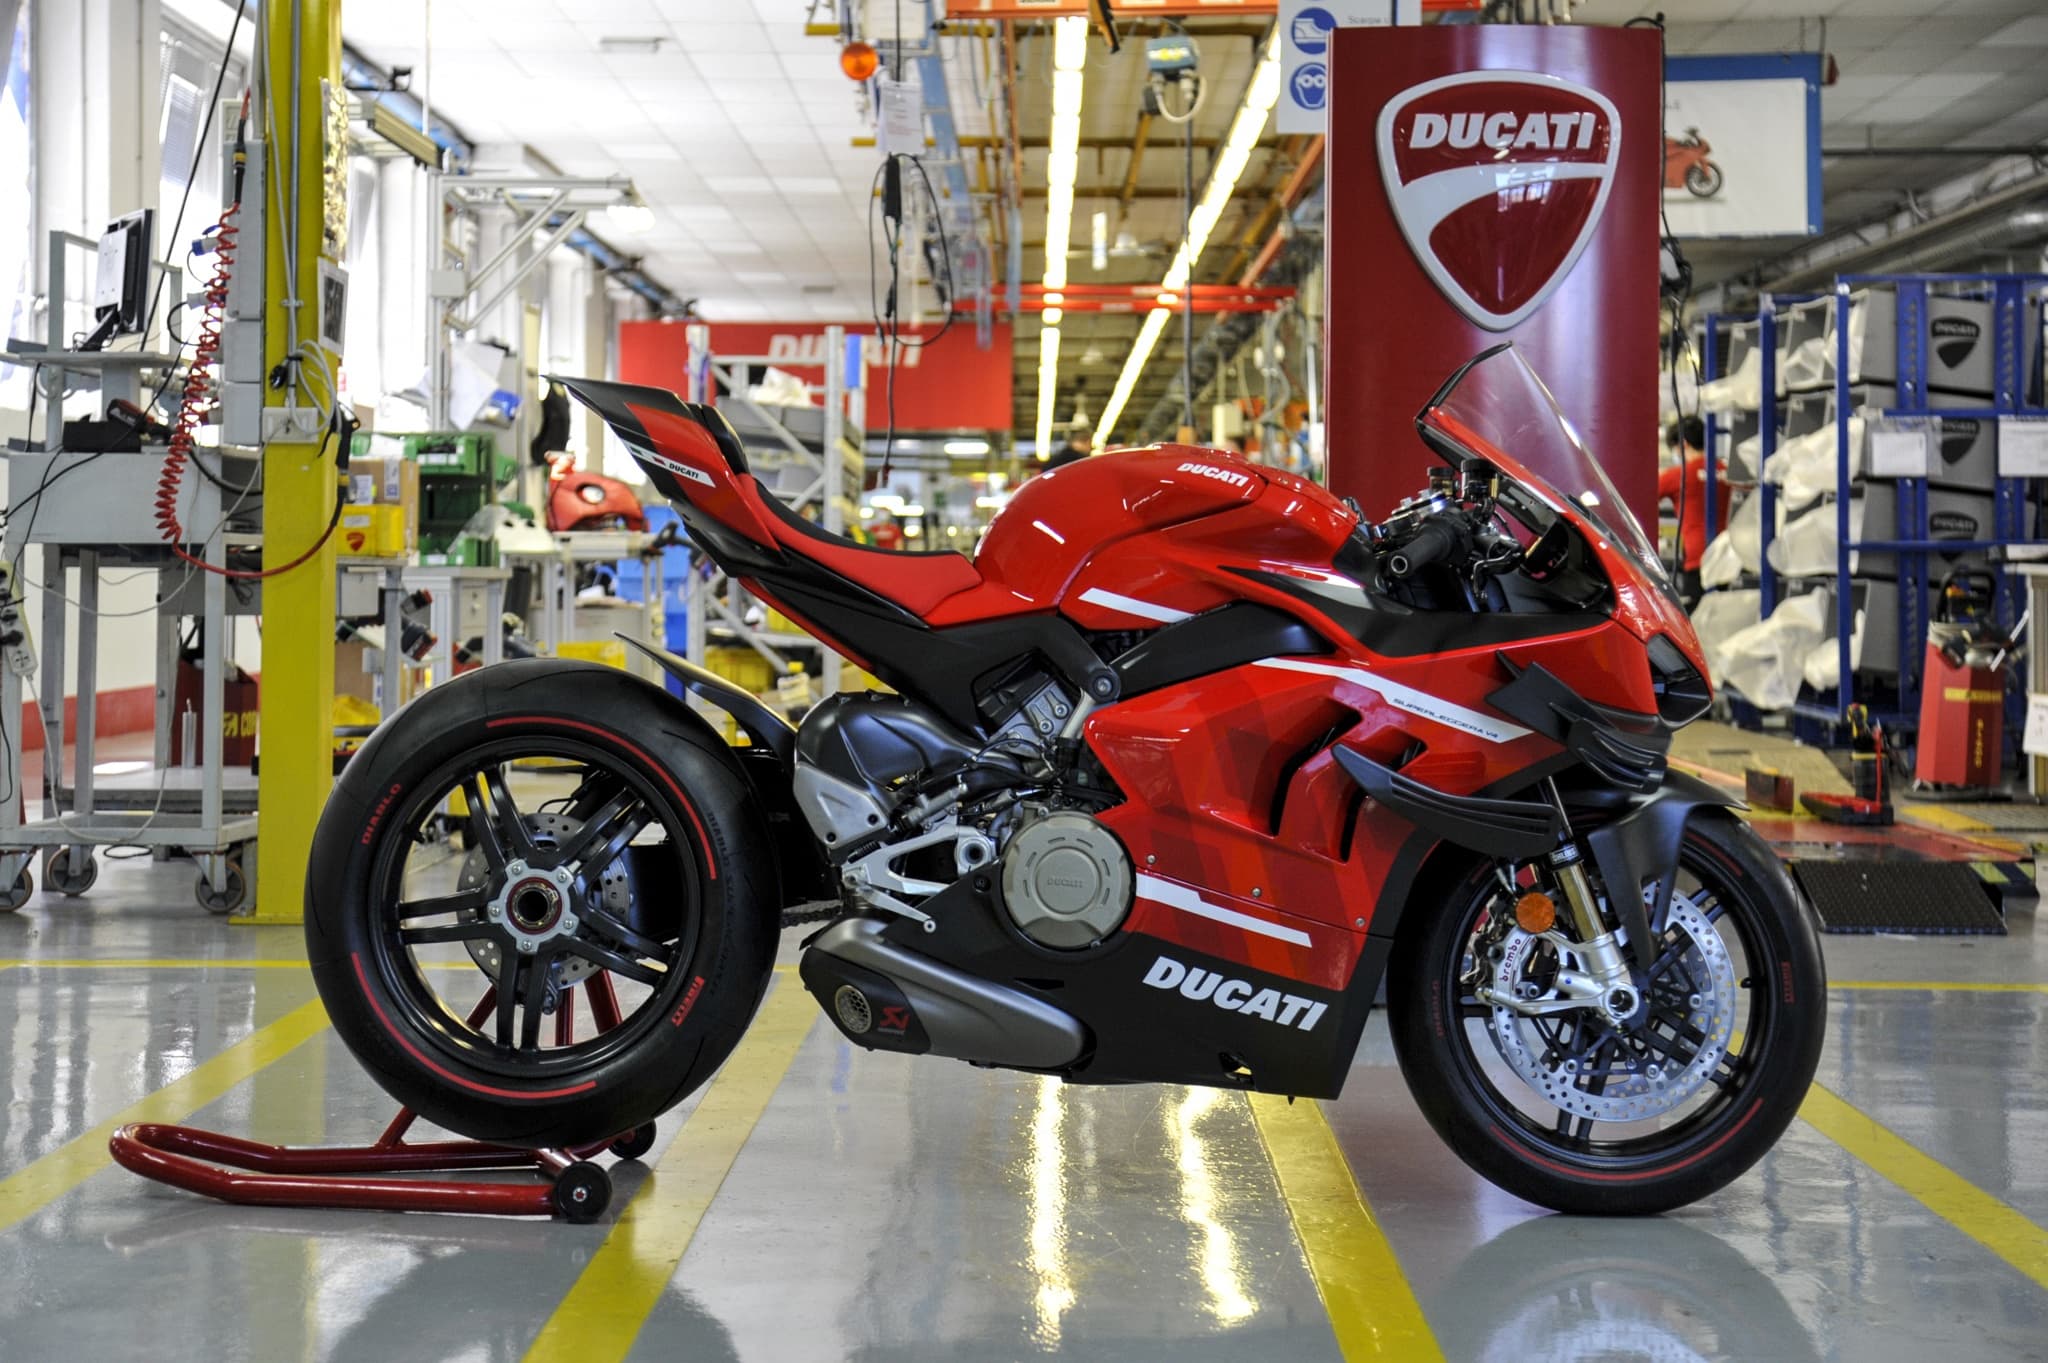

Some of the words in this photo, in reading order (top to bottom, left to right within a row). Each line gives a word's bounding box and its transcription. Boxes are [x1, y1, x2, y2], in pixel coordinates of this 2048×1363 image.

[1409, 112, 1596, 149] DUCATI
[769, 335, 922, 367] DUATI
[669, 463, 699, 479] DUCATI
[1176, 463, 1249, 487] DUCATI
[1393, 698, 1484, 734] SUPERLEGGERA
[1486, 731, 1499, 739] V4
[361, 783, 401, 844] DIABLO
[1500, 938, 1521, 982] brembo
[671, 975, 705, 1027] PIRELLI
[1142, 955, 1329, 1031] DUCATI
